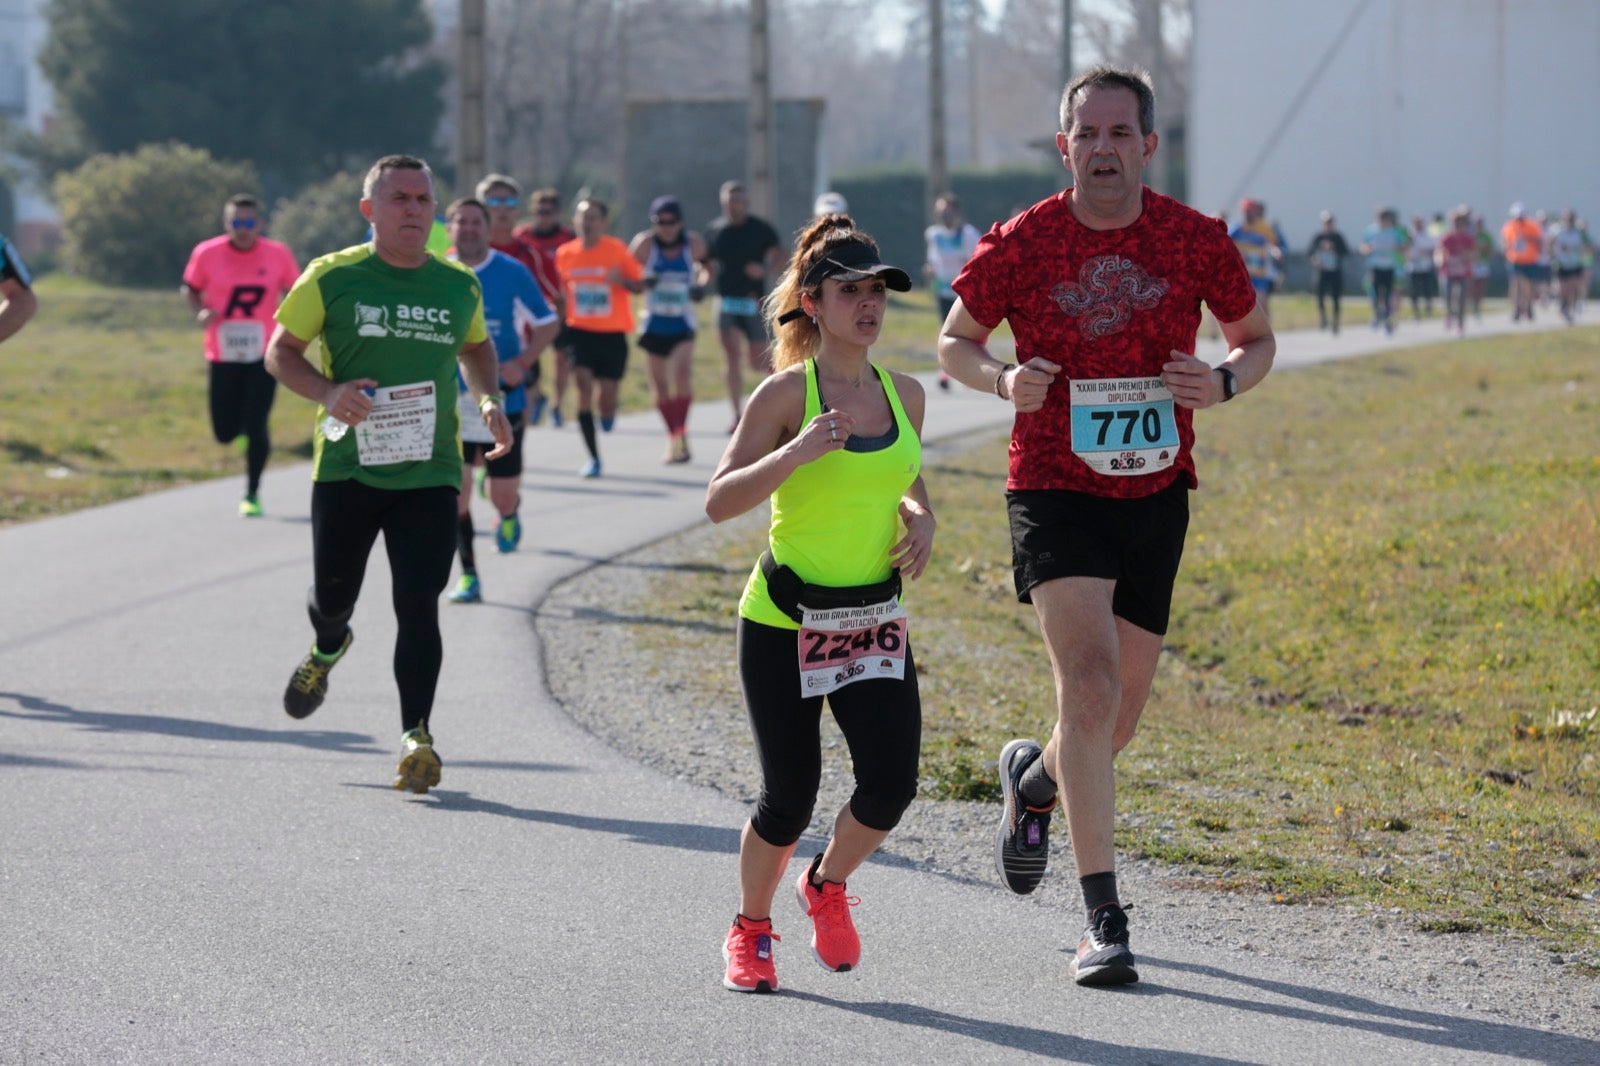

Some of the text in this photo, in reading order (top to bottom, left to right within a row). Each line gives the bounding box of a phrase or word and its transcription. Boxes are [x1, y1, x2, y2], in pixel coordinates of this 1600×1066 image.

[225, 285, 266, 318] R
[396, 304, 450, 324] aecc
[1077, 383, 1096, 393] XXXIII
[1098, 382, 1116, 392] GRAN
[1118, 381, 1142, 391] PREMIO
[1144, 380, 1151, 390] DE
[369, 413, 399, 421] CORRO
[1091, 407, 1162, 446] 770
[810, 612, 829, 622] XXXIII
[831, 610, 849, 620] GRAN
[850, 608, 875, 618] PREMIO
[876, 606, 885, 615] DE
[805, 621, 900, 663] 2246
